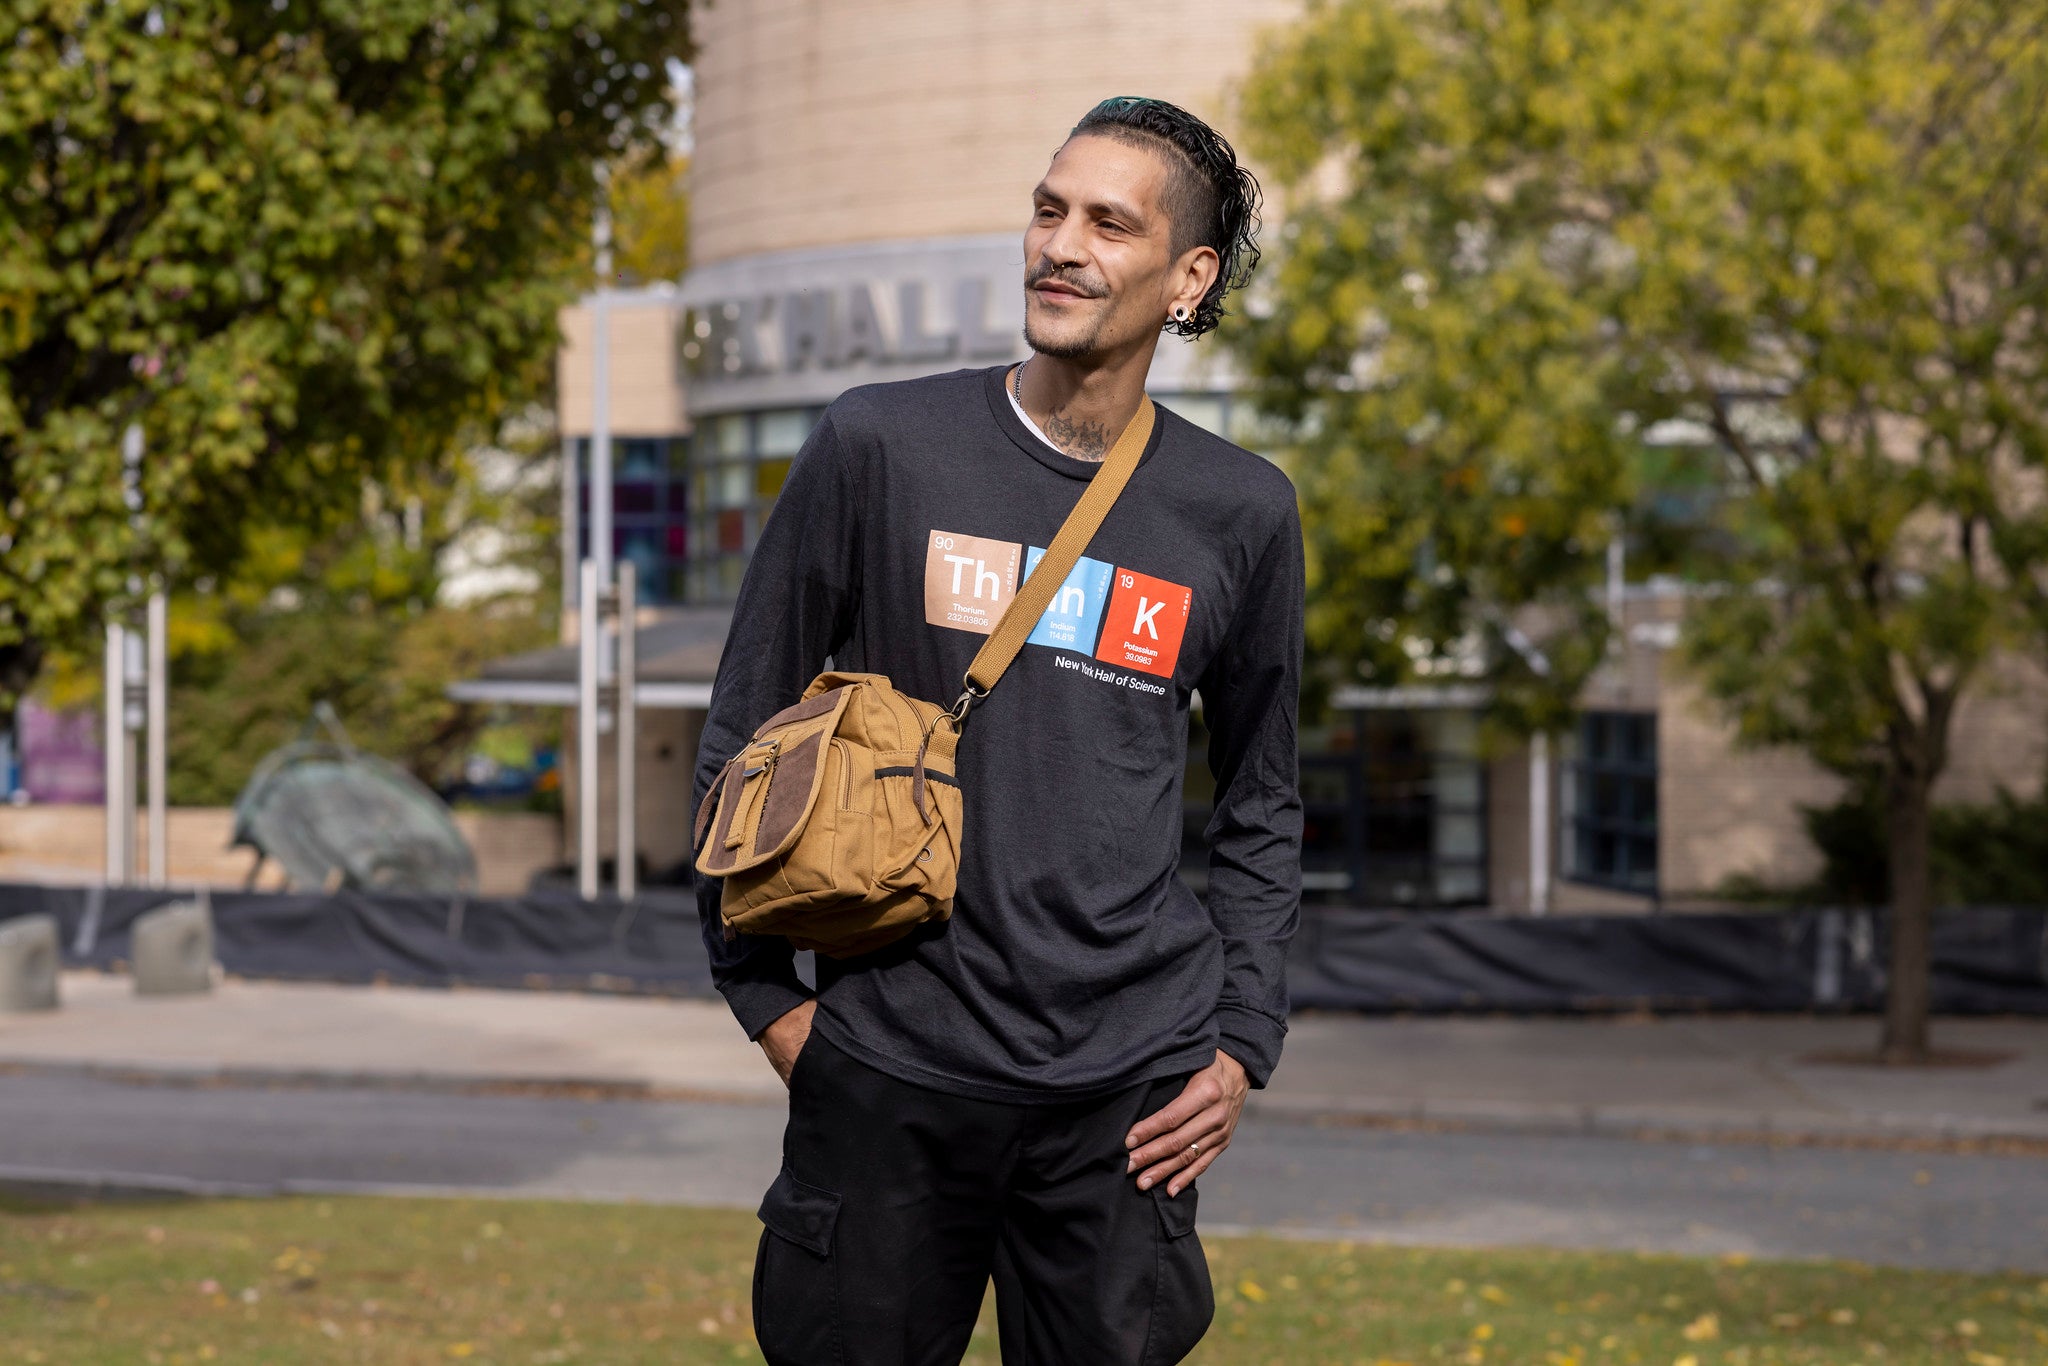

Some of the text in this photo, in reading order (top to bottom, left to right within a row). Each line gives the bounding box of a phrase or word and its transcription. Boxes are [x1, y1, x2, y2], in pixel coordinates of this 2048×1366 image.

[934, 536, 954, 551] 90
[943, 554, 1000, 602] Th
[1120, 574, 1134, 589] 19
[953, 603, 986, 616] Thorium
[1132, 596, 1166, 641] K
[1050, 621, 1076, 633] Indium
[1123, 641, 1158, 657] Potassium
[1124, 652, 1152, 666] 39.0983
[1055, 656, 1166, 696] New York Hall of Science
